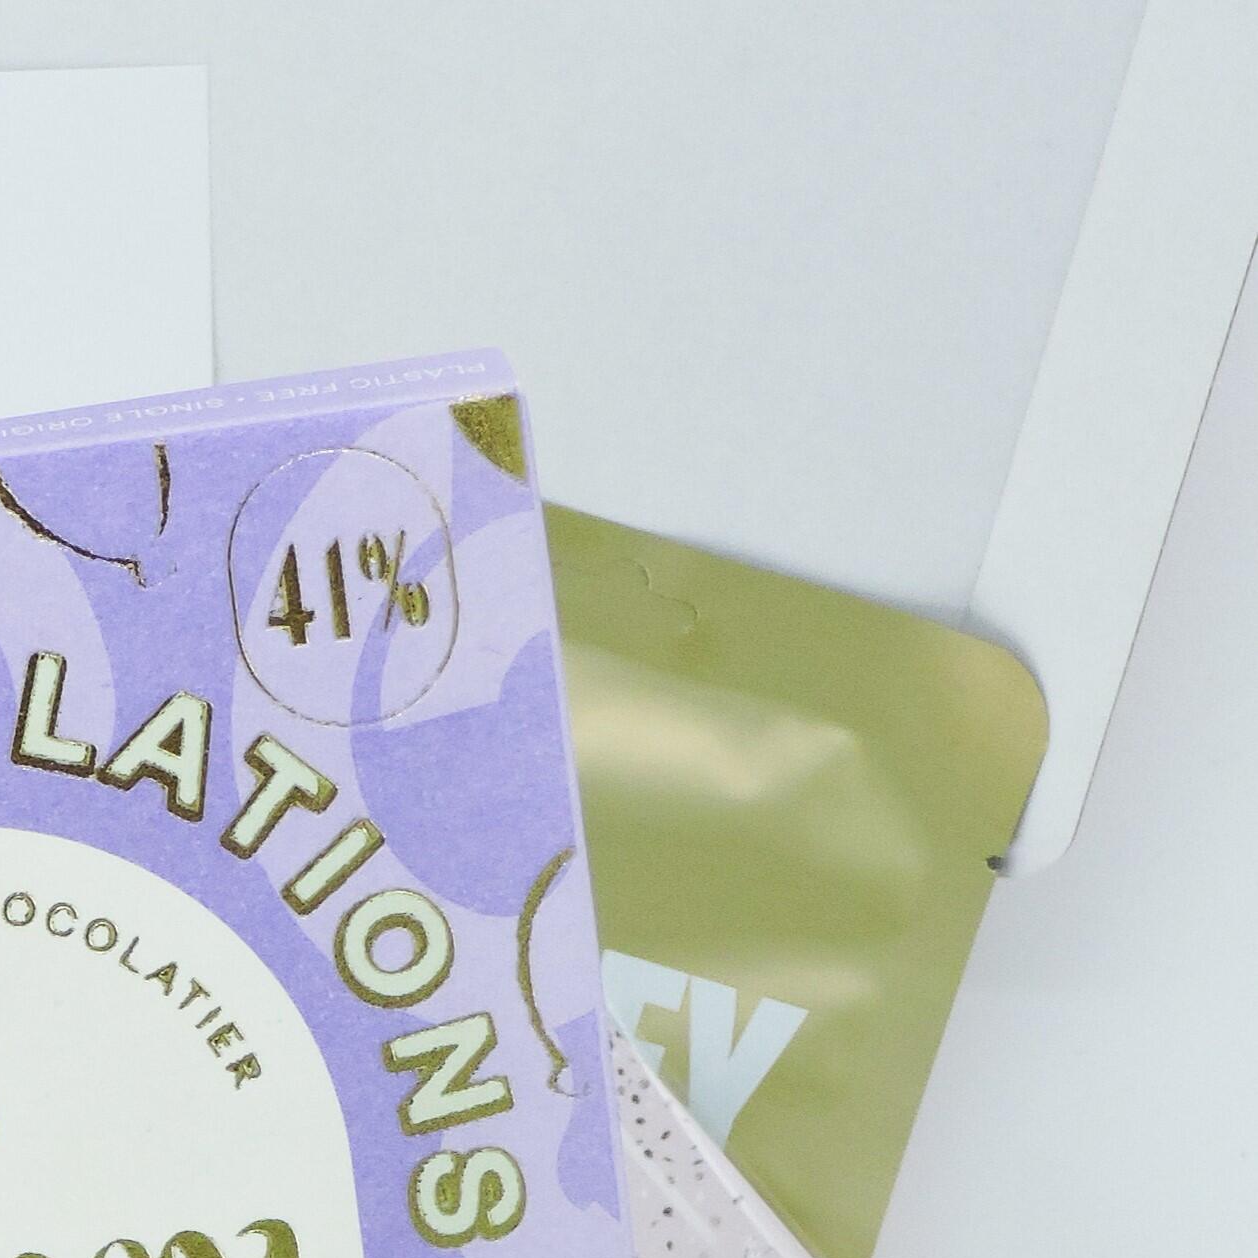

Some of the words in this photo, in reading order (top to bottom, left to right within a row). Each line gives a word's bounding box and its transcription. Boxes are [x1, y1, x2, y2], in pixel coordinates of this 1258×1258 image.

[350, 362, 487, 390] PLASTIC
[255, 382, 339, 402] FREE
[104, 397, 225, 425] SINGLE
[266, 529, 430, 647] 41%
